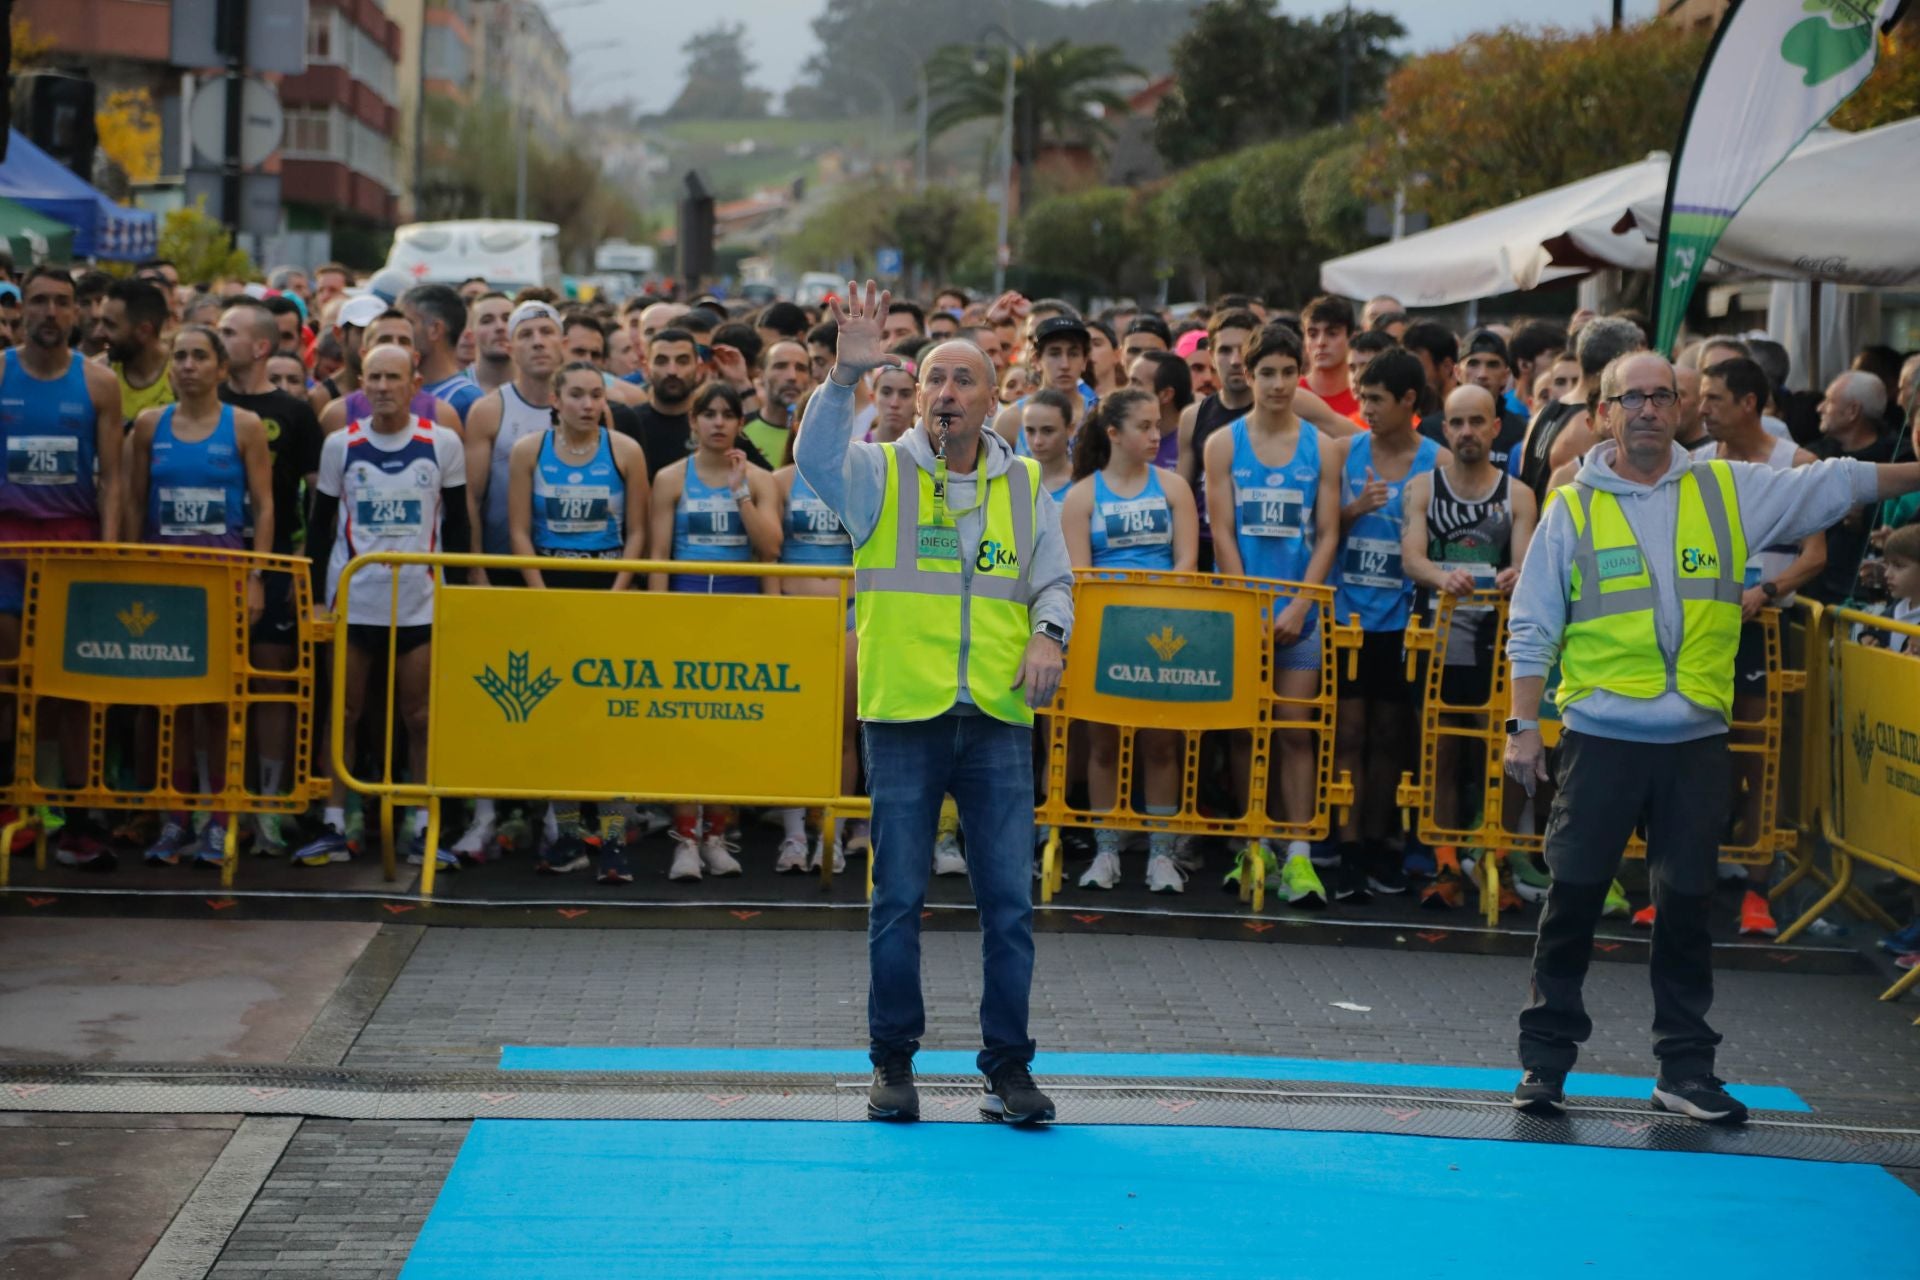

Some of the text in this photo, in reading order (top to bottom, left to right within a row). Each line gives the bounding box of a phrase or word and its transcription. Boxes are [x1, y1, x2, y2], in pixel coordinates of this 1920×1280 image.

[28, 450, 58, 471] 215
[174, 500, 208, 521] 837
[372, 500, 406, 521] 234
[559, 499, 593, 518] 787
[1262, 502, 1284, 523] 141
[711, 512, 728, 532] 10
[806, 511, 839, 531] 789
[1120, 510, 1154, 533] 784
[921, 537, 958, 549] DIEGO
[1360, 551, 1388, 573] 142
[1602, 556, 1638, 570] JUAN
[76, 641, 194, 662] CAJA RURAL
[572, 658, 800, 692] CAJA RURAL
[1108, 664, 1221, 686] CAJA RURAL
[607, 700, 764, 721] DE ASTURIAS
